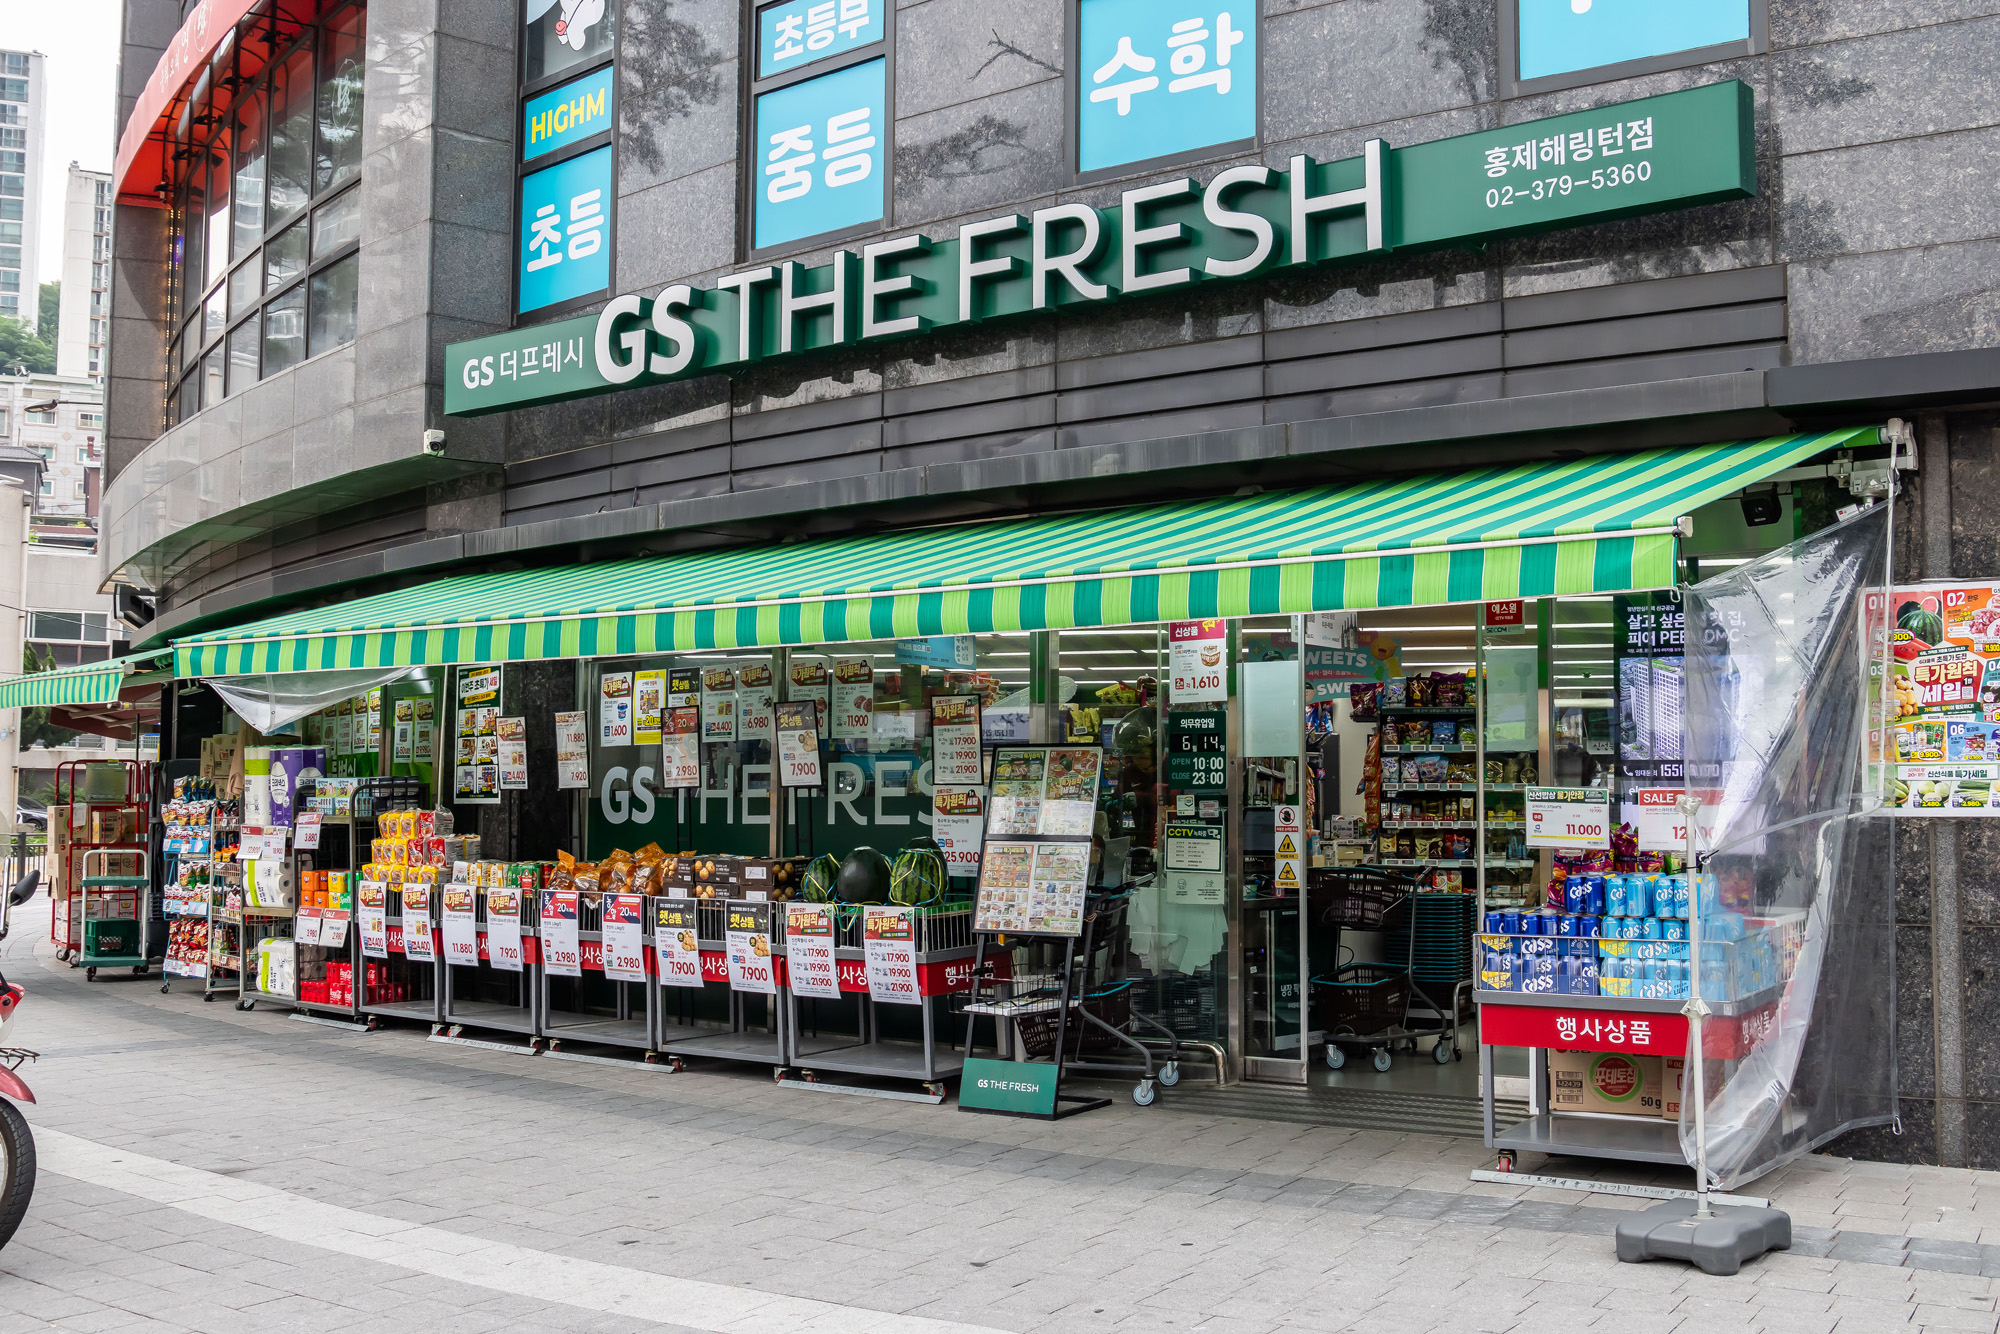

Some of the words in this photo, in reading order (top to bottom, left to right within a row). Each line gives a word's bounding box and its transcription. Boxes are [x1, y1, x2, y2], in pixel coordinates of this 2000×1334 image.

[773, 0, 870, 61] 초등부
[1089, 11, 1243, 116] 수학
[531, 88, 605, 143] HIGHM
[1484, 116, 1654, 177] 홍제해링턴점
[765, 107, 876, 203] 중등
[1486, 161, 1652, 208] 02-379-5360
[527, 189, 604, 272] 초등
[594, 285, 695, 384] GS
[717, 233, 922, 361] THE
[959, 139, 1382, 321] FRESH
[463, 356, 495, 389] GS
[499, 337, 583, 381] 더프레시
[1947, 591, 1966, 607] 02
[1492, 603, 1517, 614] 에스원
[1627, 614, 1656, 629] 살고
[1660, 613, 1684, 628] 싶은
[1175, 626, 1198, 637] 신상품
[1305, 651, 1367, 667] WEETS
[1936, 654, 1955, 663] 초특가
[835, 663, 861, 679] 특가원칙
[1915, 660, 1978, 684] 특가원칙
[1191, 676, 1220, 689] 1,610
[1317, 682, 1351, 696] SWE
[1923, 681, 1962, 703] 세일
[935, 703, 965, 720] 특가원칙
[748, 716, 769, 729] 6,980
[779, 714, 803, 728] 햇상품
[847, 714, 869, 727] 11,900
[1180, 718, 1215, 728] 의무휴업일
[611, 725, 627, 737] 1,600
[1950, 724, 1965, 736] 06
[954, 736, 977, 745] 17,900
[1182, 736, 1190, 750] 6
[1204, 736, 1219, 749] 14
[955, 751, 977, 760] 19,900
[790, 762, 817, 776] 7,900
[956, 765, 978, 774] 21,900
[1193, 757, 1224, 770] 10:00
[1192, 772, 1224, 784] 23:00
[1928, 769, 1953, 778] 신선식품
[1955, 769, 1988, 779] 특가세일
[601, 766, 656, 825] GS
[935, 793, 966, 809] 특가원칙
[1528, 791, 1556, 800] 신선밥상
[1557, 790, 1585, 802] 물가안정
[1643, 793, 1674, 803] SALE
[1168, 828, 1193, 836] CCTV
[1566, 824, 1602, 836] 11.000
[945, 851, 980, 863] 25,900
[444, 892, 465, 906] 특가원칙
[488, 895, 511, 909] 특가원칙
[299, 908, 310, 916] SALE
[325, 911, 336, 919] SALE
[659, 910, 682, 924] 햇상품
[730, 913, 755, 929] 햇상품
[788, 913, 818, 929] 특가원칙
[867, 917, 898, 933] 특가원칙
[808, 948, 829, 958] 17,900
[1671, 944, 1687, 954] LIGHT
[886, 953, 910, 963] 17,900
[669, 961, 695, 975] 7,900
[740, 966, 768, 981] 7,900
[809, 963, 830, 973] 19,900
[888, 968, 911, 978] 19,900
[811, 977, 832, 987] 21,900
[890, 983, 913, 992] 21,900
[1639, 980, 1672, 998] Cass
[1673, 986, 1689, 995] LIGHT
[1556, 1017, 1652, 1045] 행사상품
[1743, 1011, 1770, 1044] 행상품
[1592, 1065, 1639, 1087] 포테토칩
[978, 1079, 988, 1088] GS
[990, 1080, 1007, 1090] THE
[1009, 1081, 1039, 1093] FRESH
[1641, 1097, 1653, 1107] 50
[1655, 1099, 1661, 1109] g
